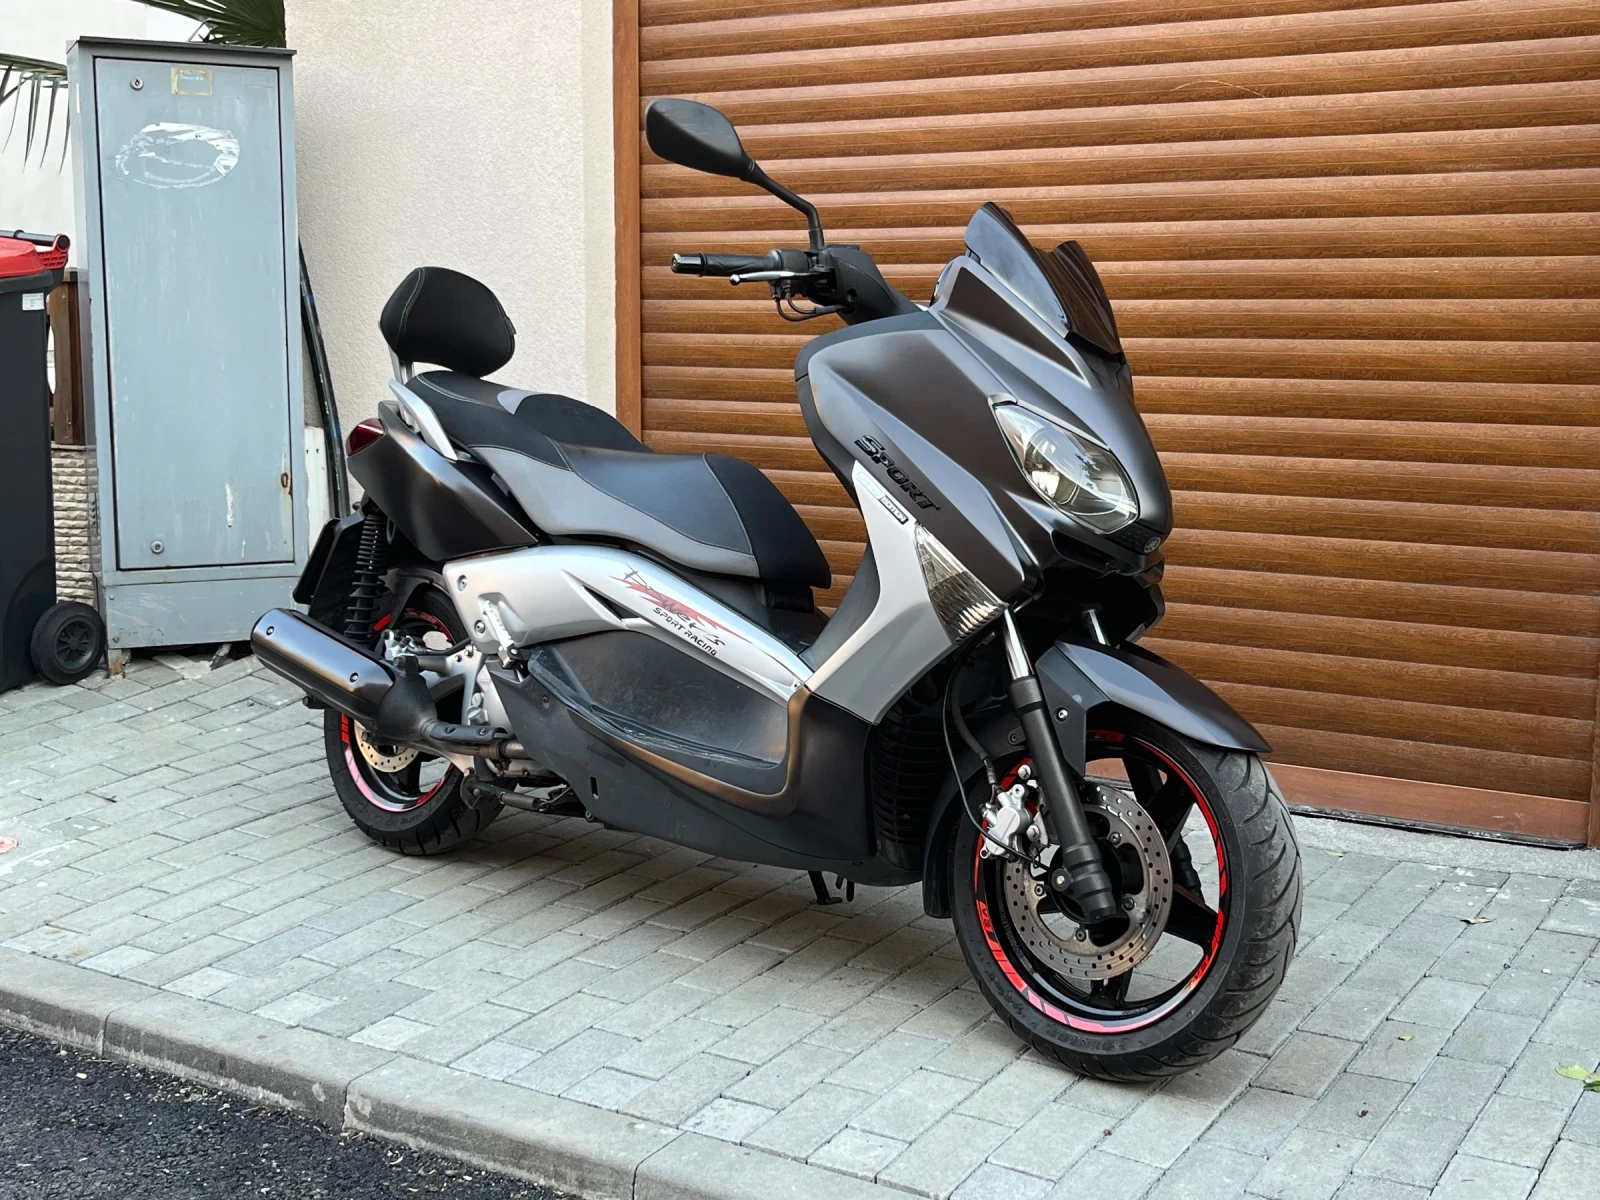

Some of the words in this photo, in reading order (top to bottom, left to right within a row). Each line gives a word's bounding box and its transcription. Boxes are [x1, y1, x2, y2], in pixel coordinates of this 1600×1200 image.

[854, 435, 941, 511] SPORT
[653, 607, 686, 632] SPORT
[684, 629, 719, 657] RACING
